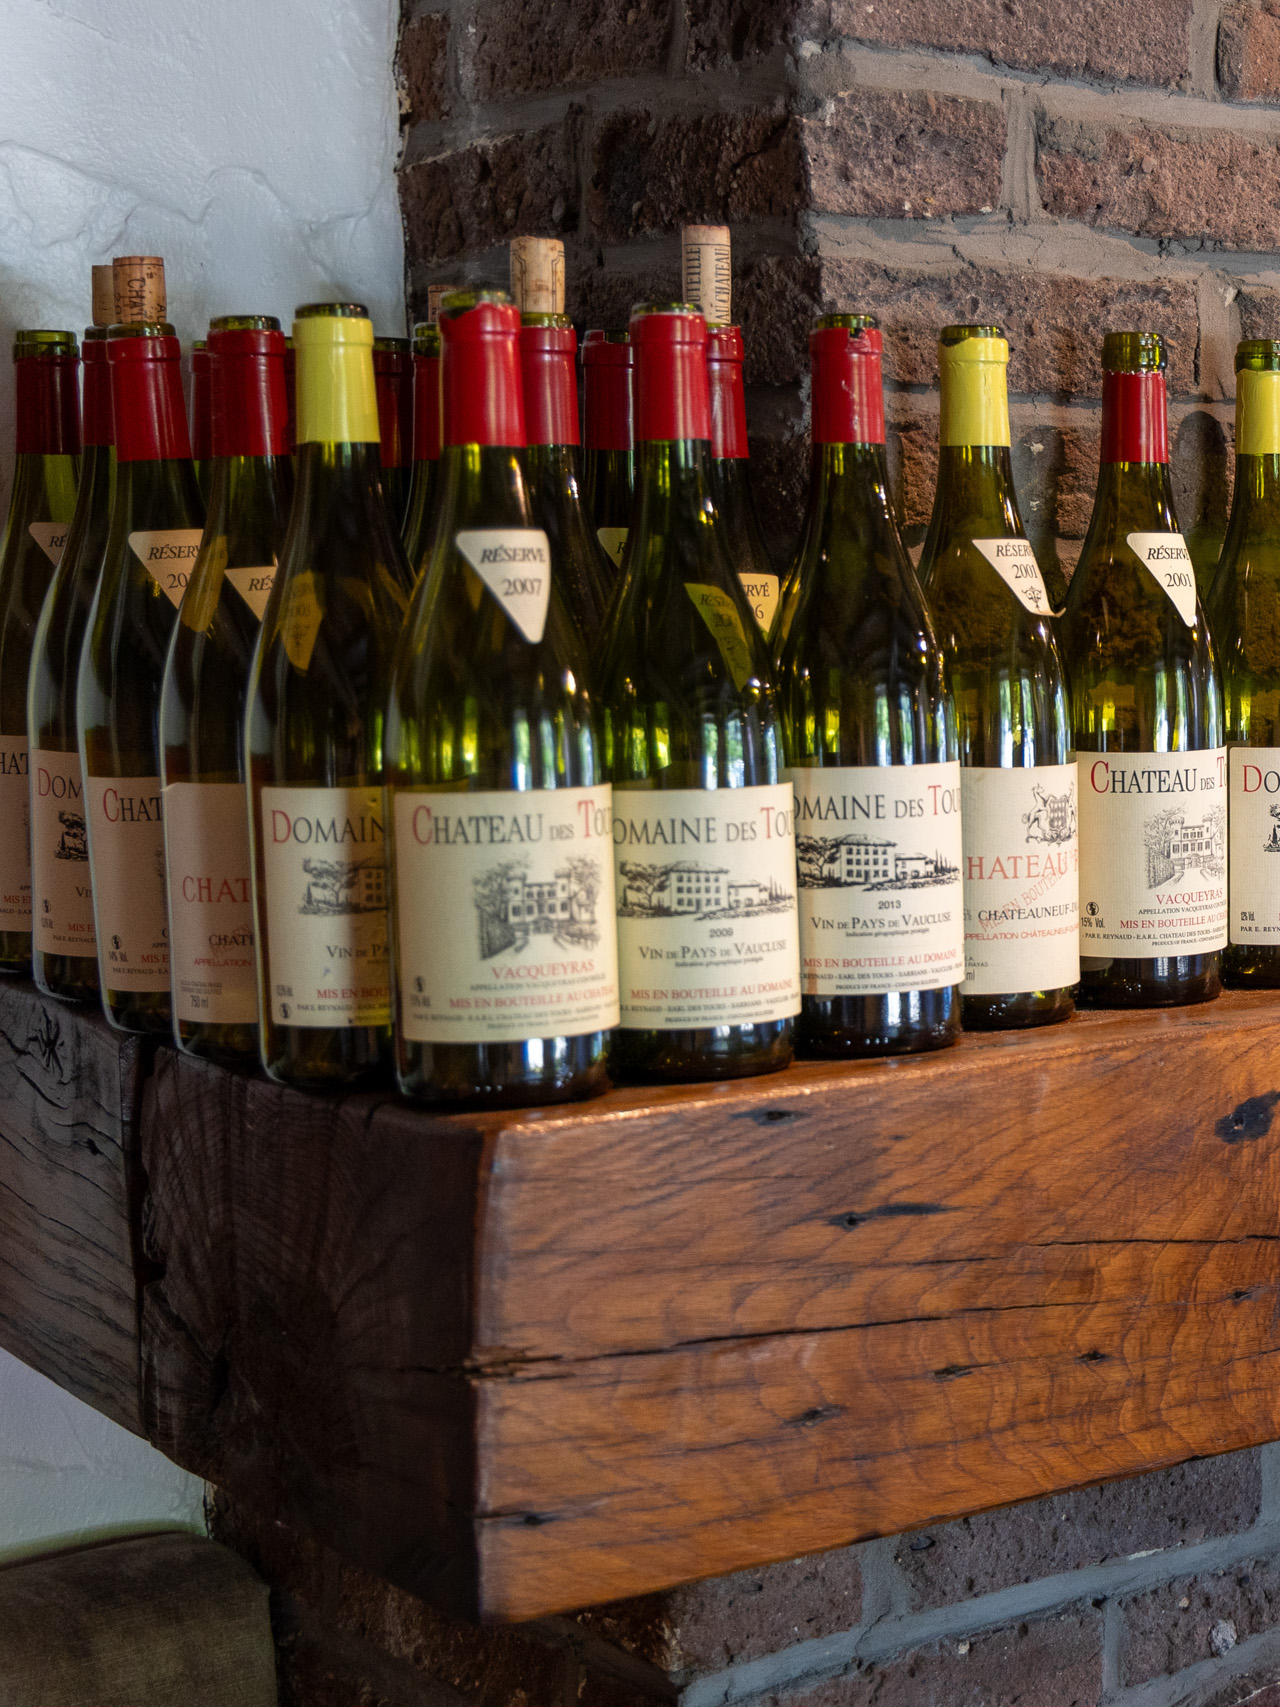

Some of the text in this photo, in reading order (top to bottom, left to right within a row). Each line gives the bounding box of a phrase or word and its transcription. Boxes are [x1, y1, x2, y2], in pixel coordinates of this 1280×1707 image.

[480, 544, 546, 563] RÉSERVE
[1012, 564, 1038, 579] 2001
[502, 578, 541, 596] 2007
[1164, 573, 1192, 588] 2001
[1090, 760, 1215, 793] CHATEAU DES
[894, 799, 923, 819] DES
[413, 805, 574, 845] CHATEAU DES
[725, 822, 757, 842] DES
[878, 900, 902, 910] 2013
[1156, 888, 1223, 905] VACQUEYRAS
[1138, 906, 1180, 915] APPELLATION
[811, 916, 835, 929] VIN
[851, 916, 886, 929] PAYS
[888, 920, 899, 928] DE
[901, 912, 951, 926] VAUCLUSE
[1080, 917, 1106, 929] 15% Vol.
[1120, 913, 1217, 929] MIS EN BOUTEILLE AU
[639, 945, 663, 960] VIN
[666, 951, 679, 959] DE
[681, 946, 717, 959] PAYS
[803, 949, 957, 968] MIS EN BOUTEILLE AU DOMAINE
[492, 958, 594, 979] VACQUEYRAS
[631, 979, 793, 1000] MIS EN BOUTEILLE AU DOMAINE
[450, 998, 471, 1008] MIS
[474, 998, 492, 1007] EN
[494, 991, 562, 1007] BOUTEILLE
